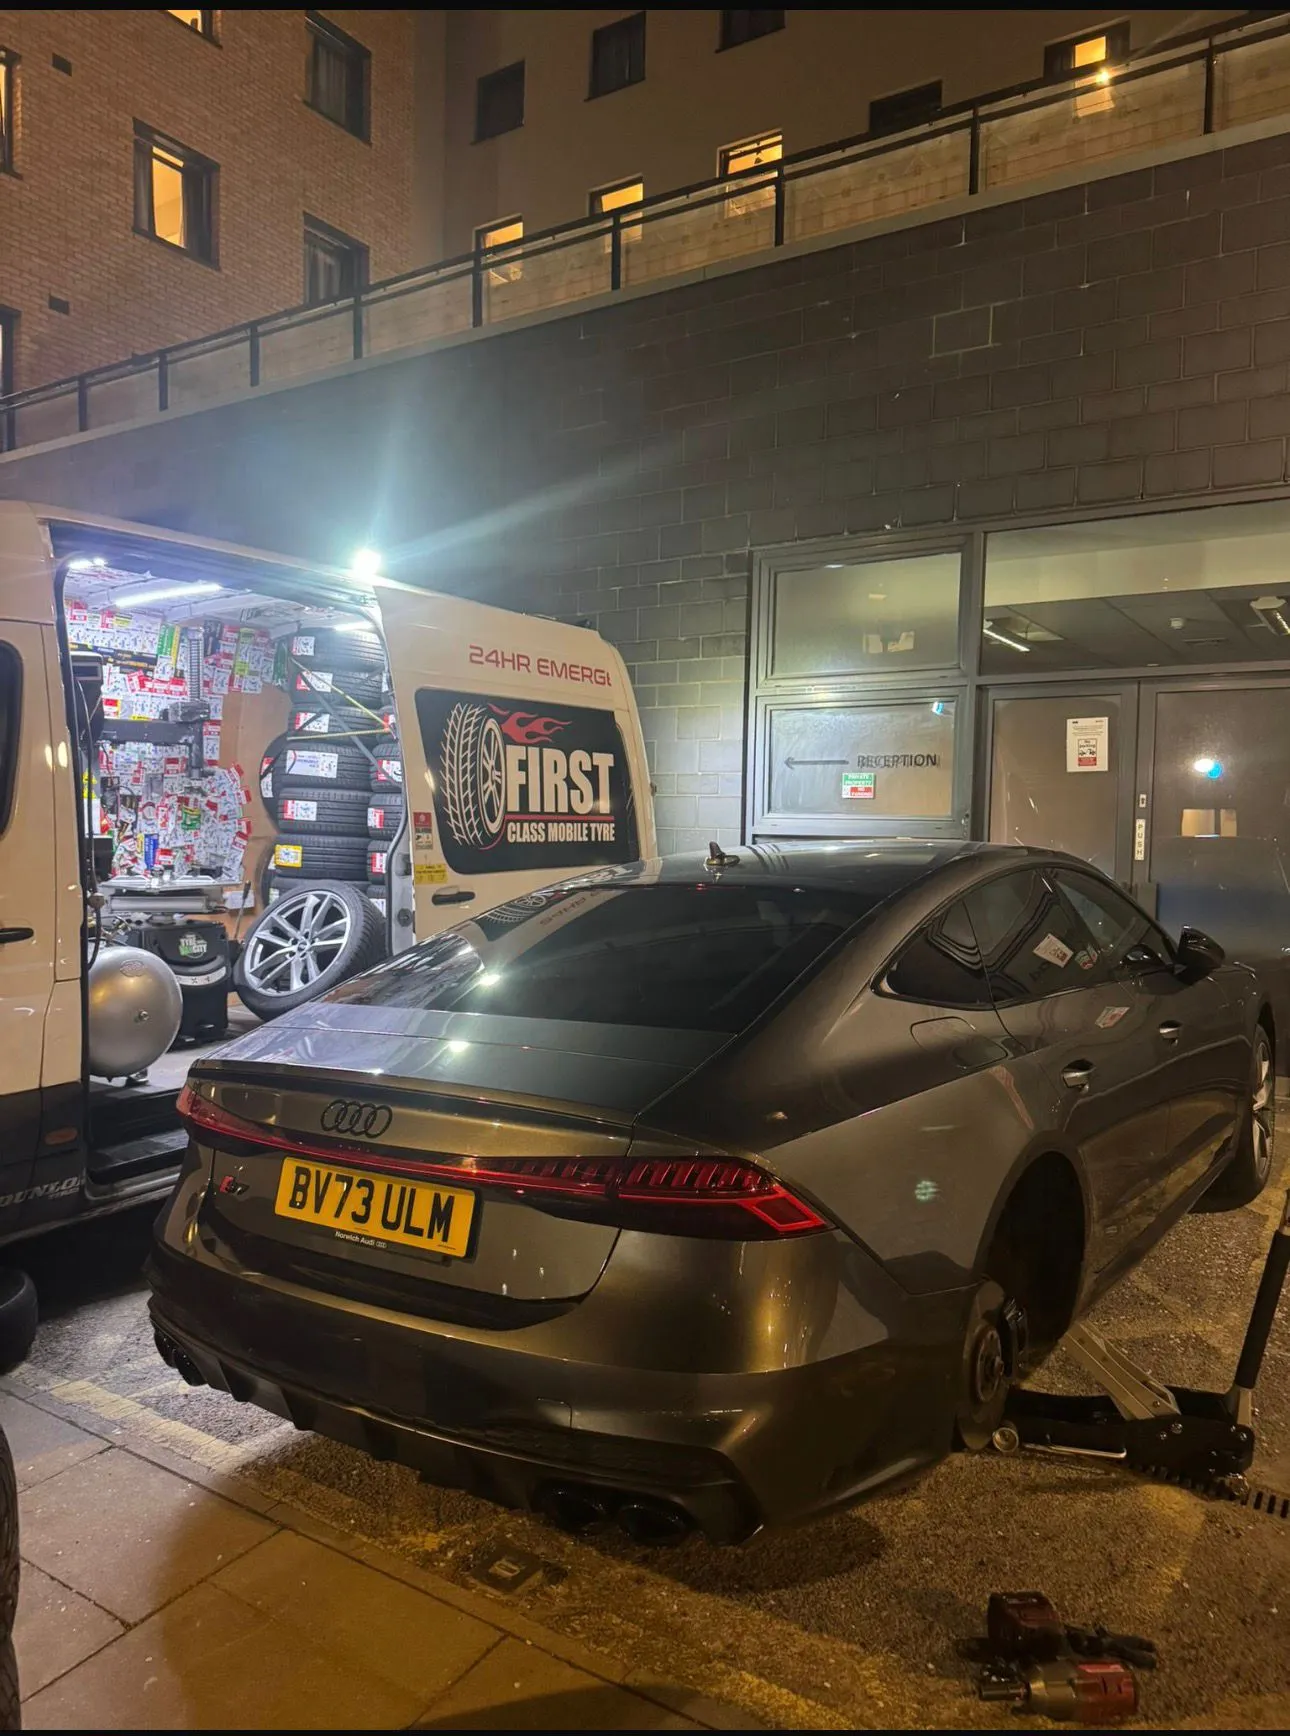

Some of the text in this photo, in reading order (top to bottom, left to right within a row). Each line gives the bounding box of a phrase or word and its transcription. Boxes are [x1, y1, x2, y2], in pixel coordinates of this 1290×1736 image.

[469, 644, 531, 673] 24HR
[857, 753, 938, 768] RECEPTION
[505, 744, 614, 815] FIRST
[507, 822, 616, 843] CLASS MOBILE TYRE
[288, 1166, 456, 1243] BV73 ULM
[335, 1230, 376, 1247] Norwich Audi
